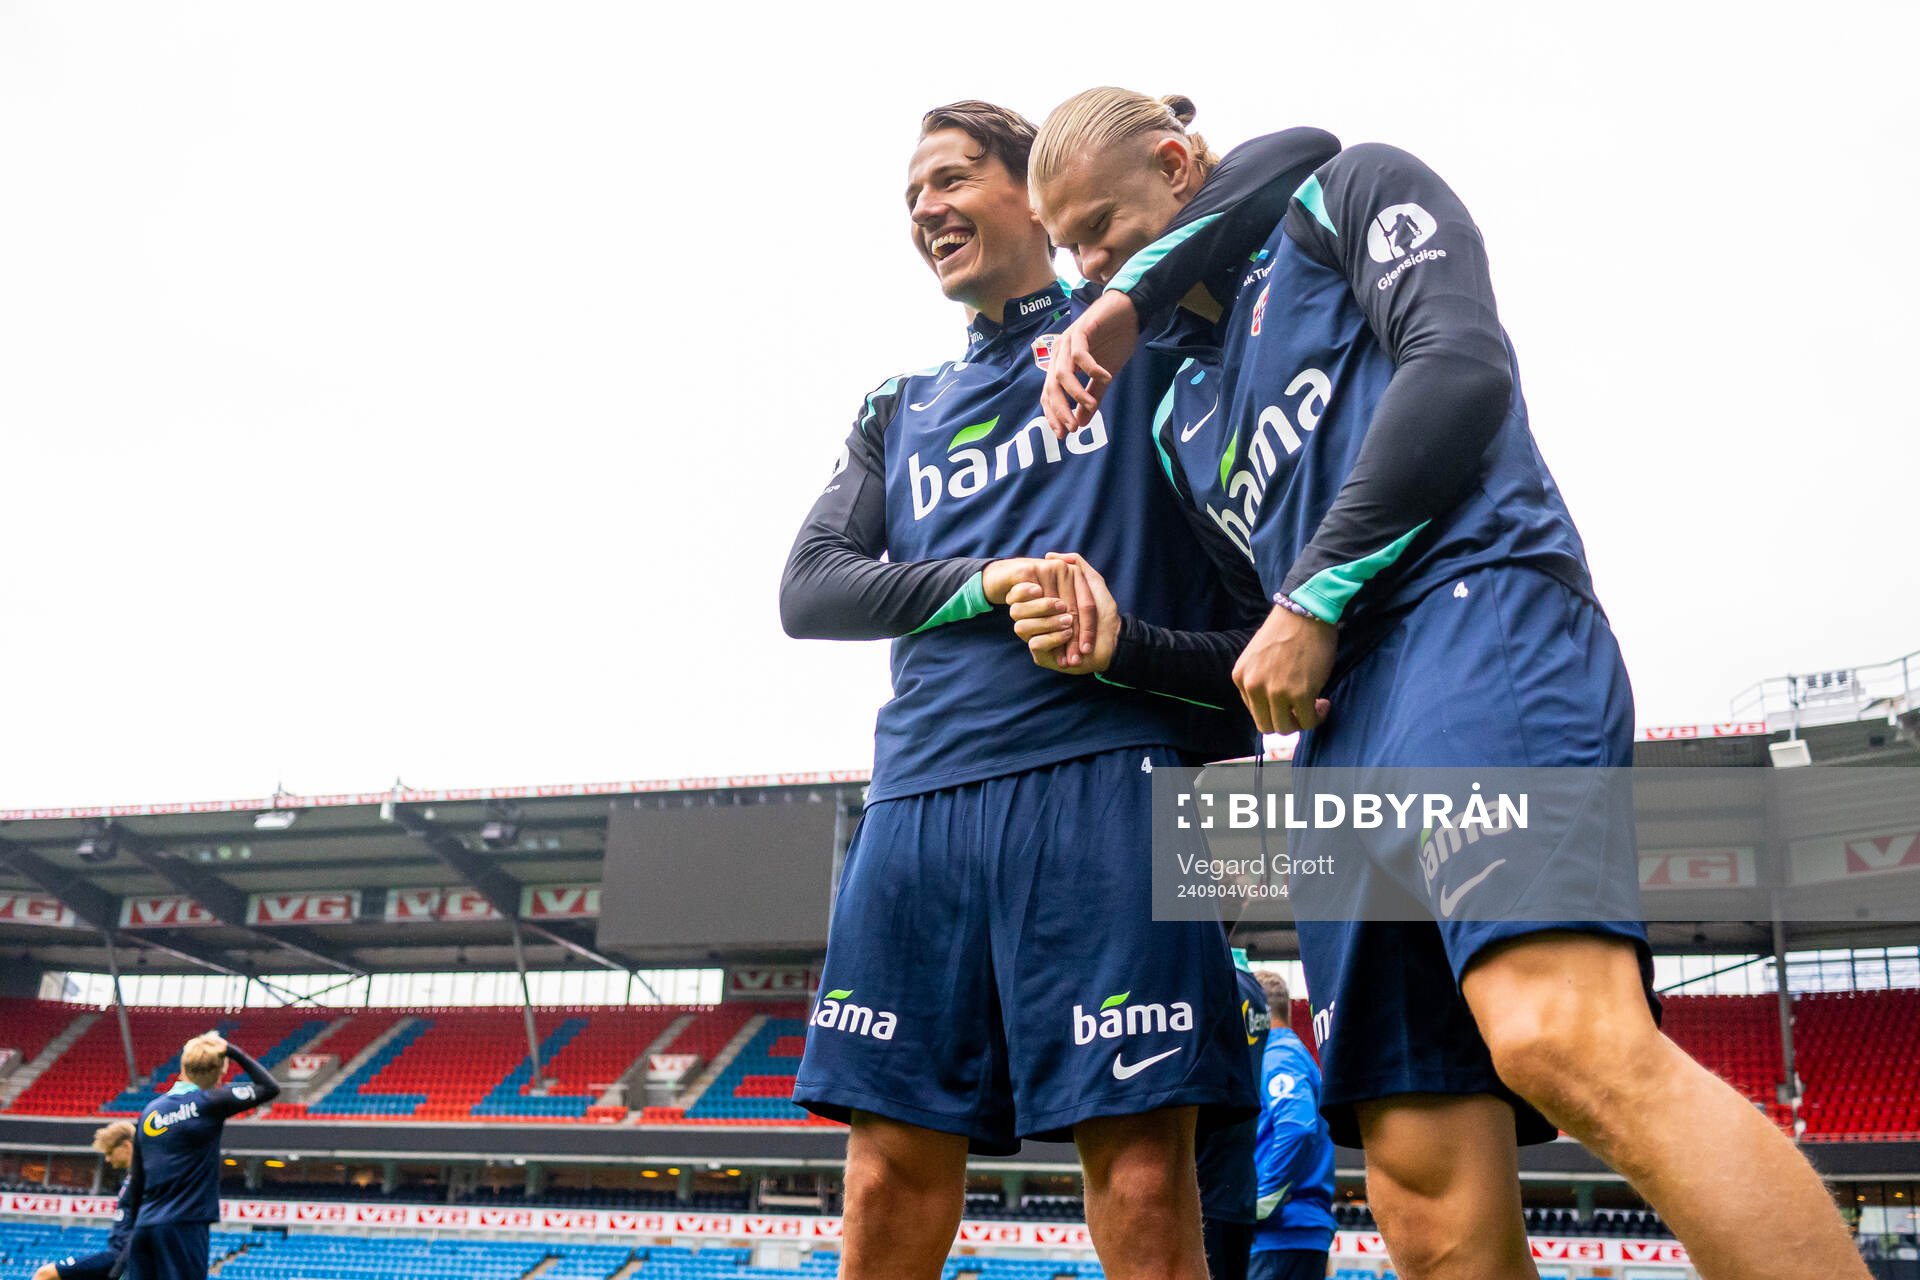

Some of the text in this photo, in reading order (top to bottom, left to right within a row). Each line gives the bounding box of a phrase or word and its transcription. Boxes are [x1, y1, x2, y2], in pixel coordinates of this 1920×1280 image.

[1377, 249, 1447, 290] Gjensidige
[1020, 296, 1052, 315] bama
[908, 409, 1109, 521] bama
[1453, 581, 1469, 598] 4
[1140, 756, 1153, 773] 4
[259, 895, 350, 921] VG
[734, 969, 809, 990] VG
[1073, 1002, 1193, 1045] bama
[1531, 1241, 1604, 1259] VG
